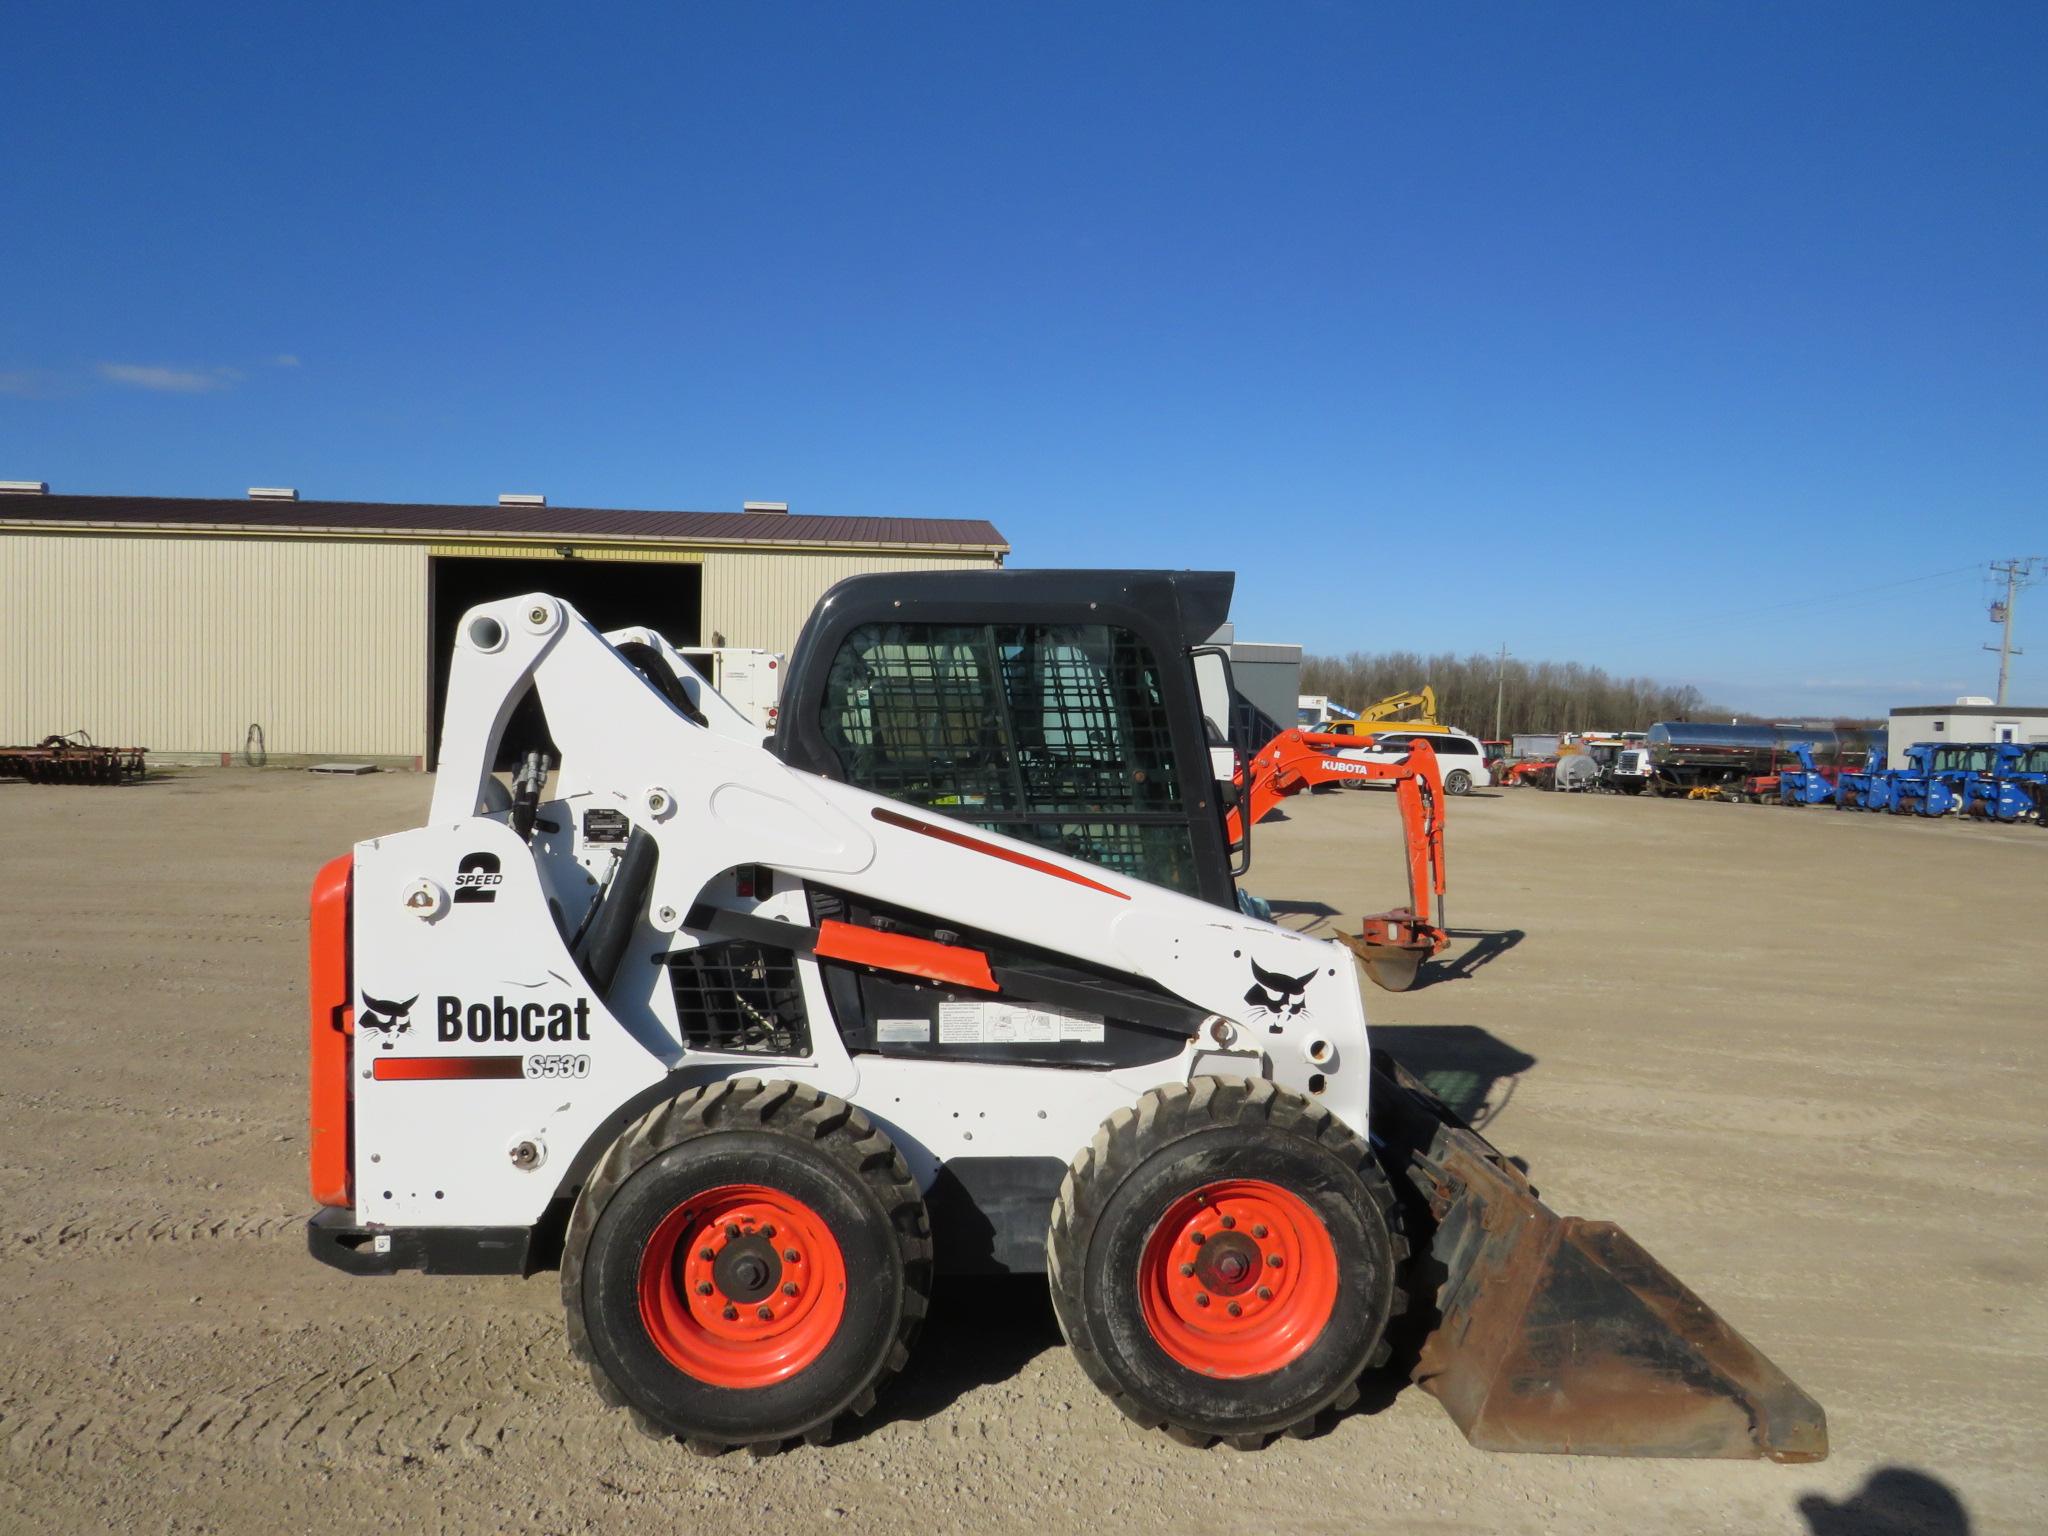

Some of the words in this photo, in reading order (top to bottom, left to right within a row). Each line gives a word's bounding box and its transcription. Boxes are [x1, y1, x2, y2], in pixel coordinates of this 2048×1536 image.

[1321, 760, 1367, 774] KUBOTA
[453, 851, 501, 904] 2
[455, 874, 503, 886] SPEED
[437, 996, 590, 1042] Bobcat
[526, 1054, 592, 1079] S530
